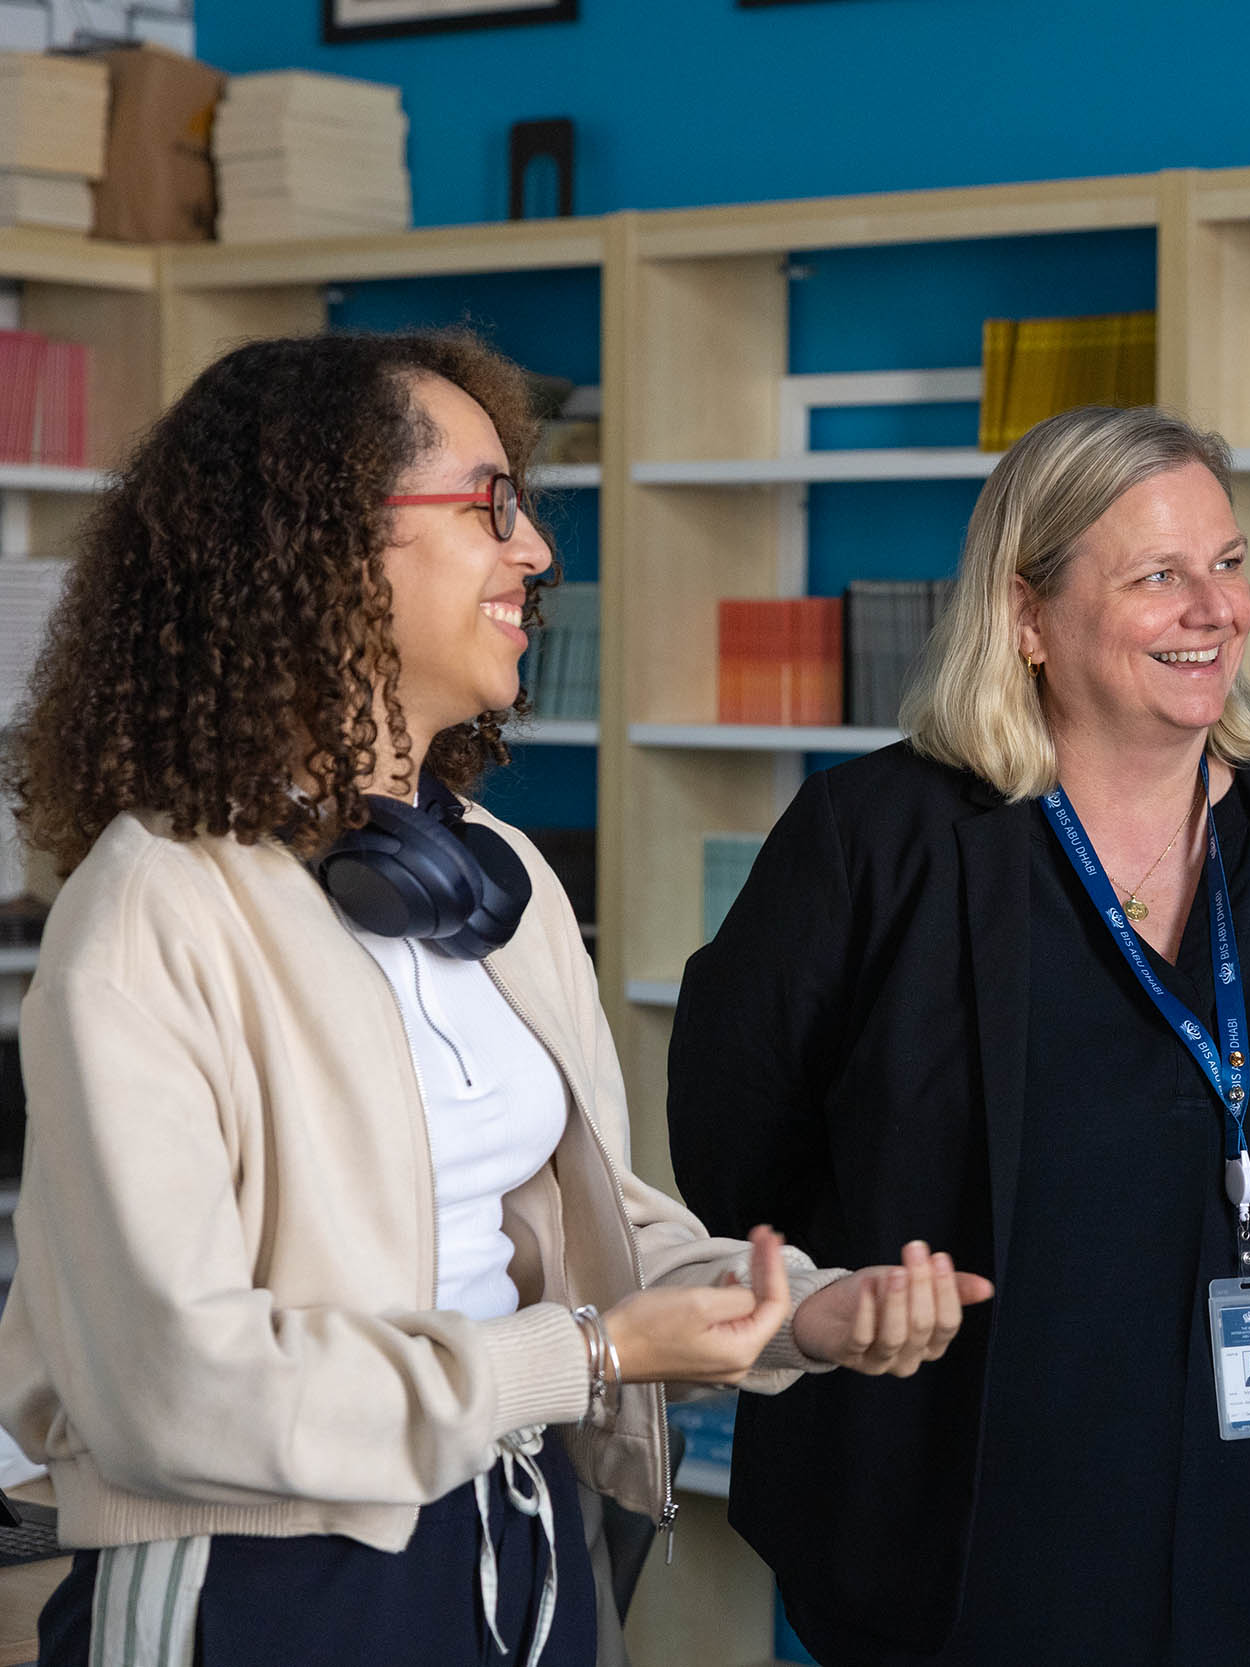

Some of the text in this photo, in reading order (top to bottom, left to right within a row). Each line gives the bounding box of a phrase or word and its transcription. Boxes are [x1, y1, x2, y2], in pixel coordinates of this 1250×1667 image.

[1056, 809, 1098, 876] BIS ABU DHABI
[1216, 890, 1230, 960] BIS ABU DHABI
[1120, 931, 1164, 996] BIS ABU DHABI
[1198, 1042, 1213, 1059] BIS
[1208, 1060, 1221, 1082] ABU
[1227, 1018, 1240, 1048] DHABI
